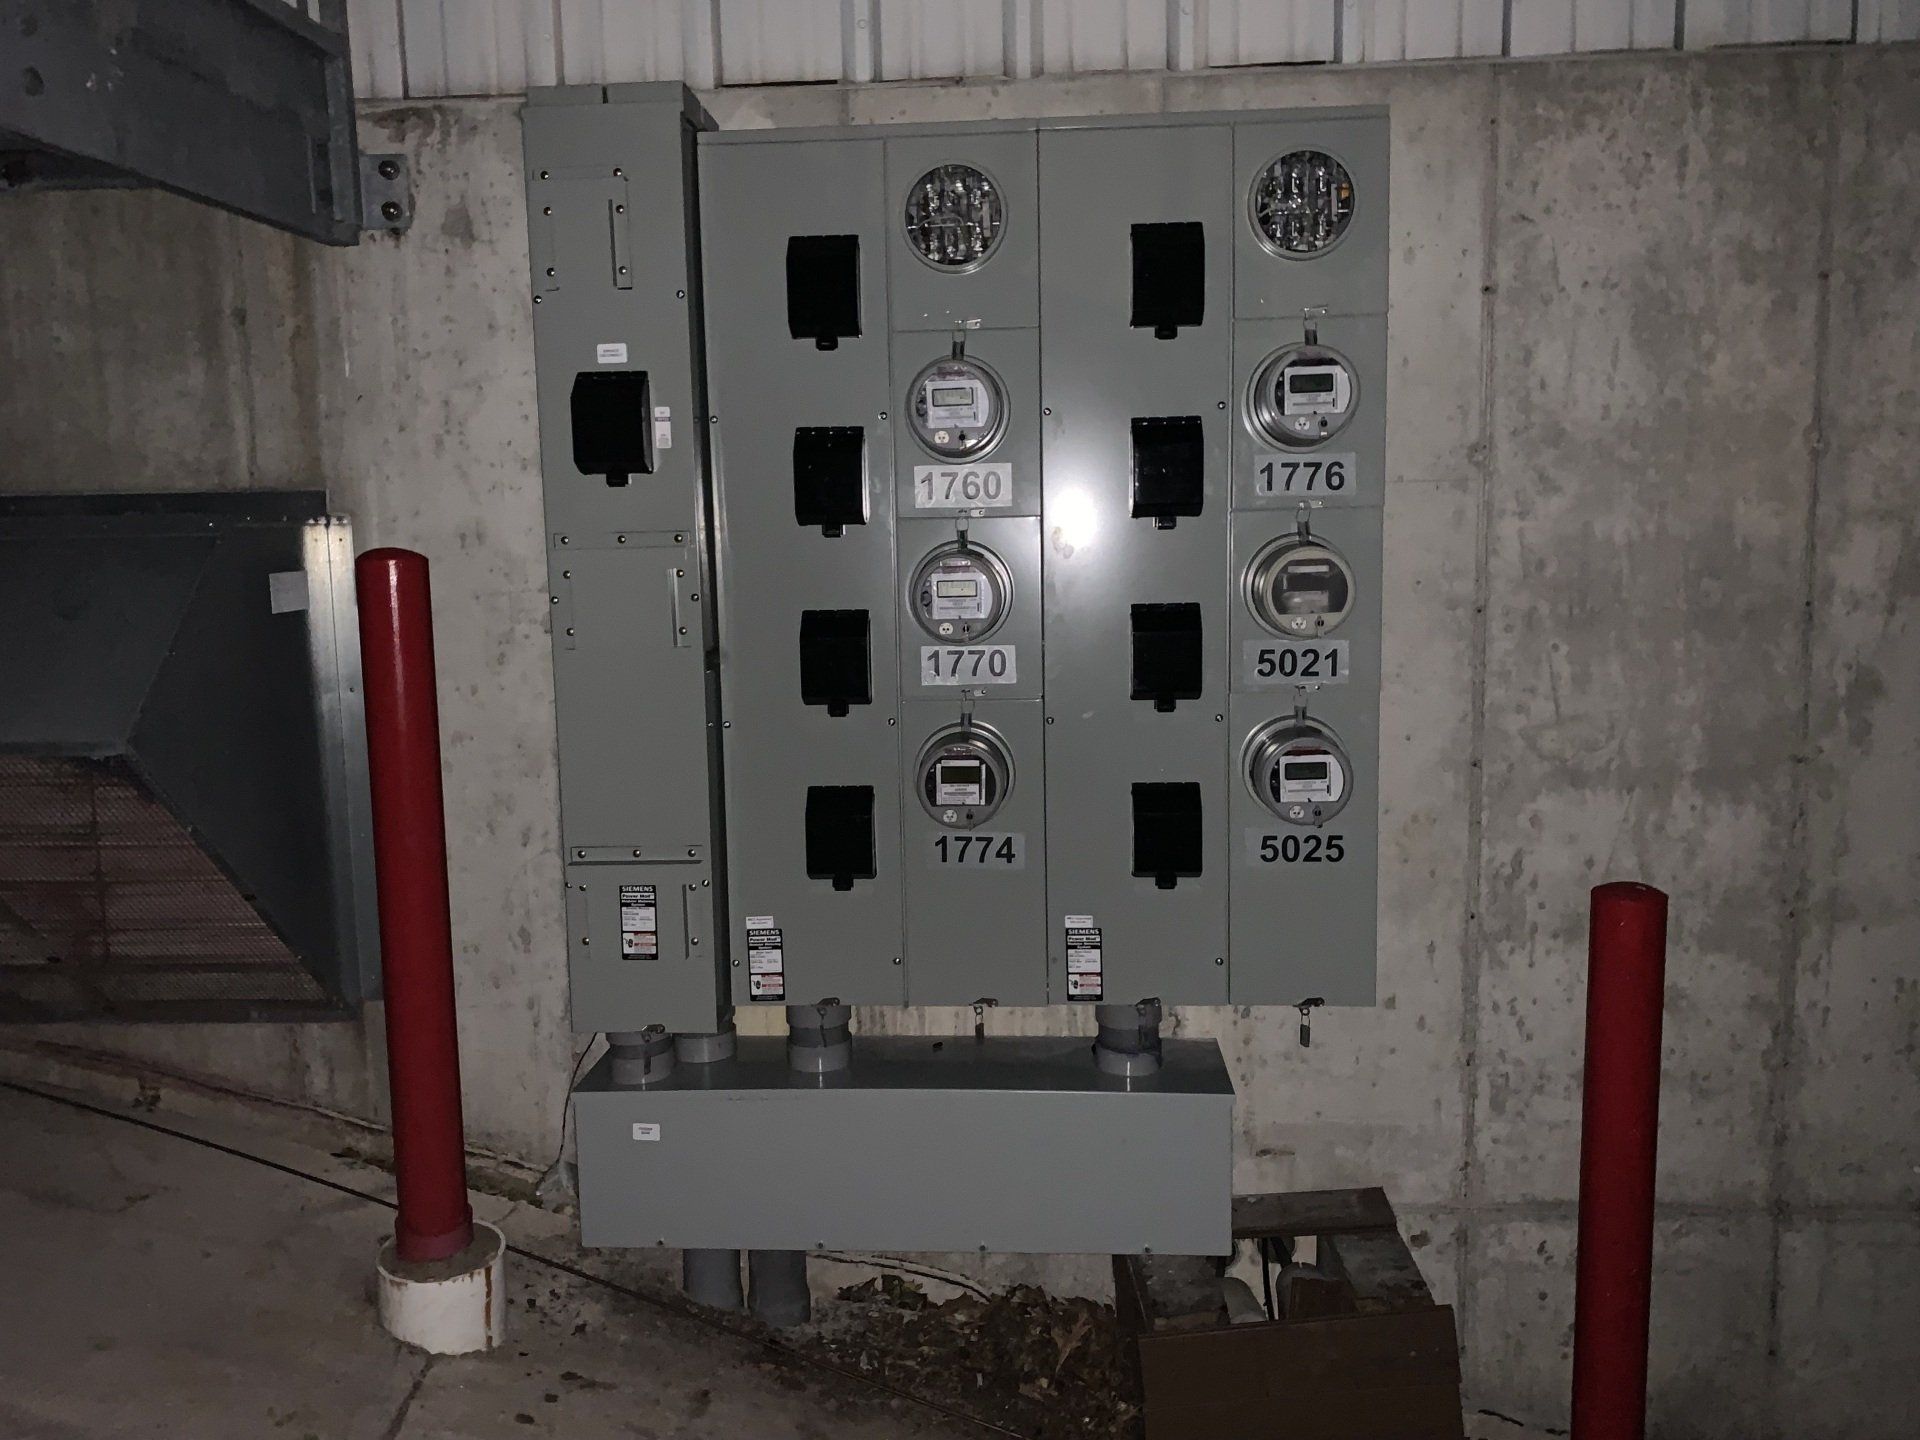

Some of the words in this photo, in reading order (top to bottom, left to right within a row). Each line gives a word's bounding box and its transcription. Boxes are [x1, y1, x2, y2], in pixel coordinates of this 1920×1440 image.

[920, 470, 1002, 501] 1760
[1259, 461, 1345, 492] 1776
[927, 649, 1007, 678] 1770
[1257, 648, 1339, 677] 5021
[934, 835, 1016, 864] 1774
[1259, 834, 1345, 863] 5025
